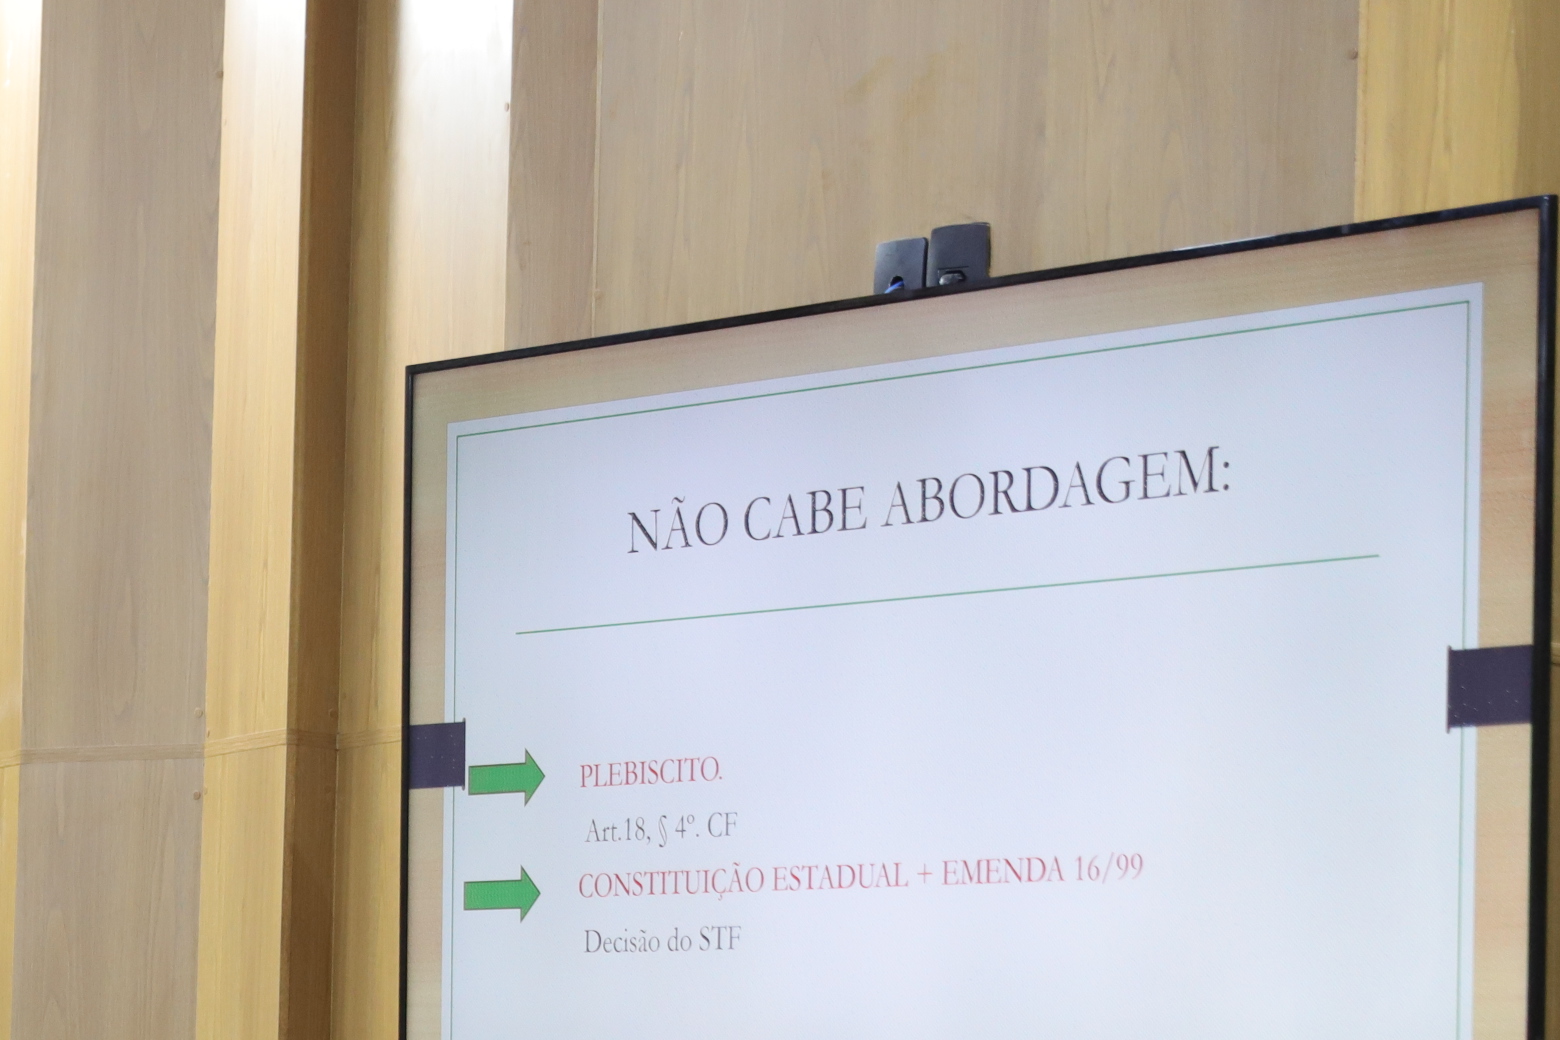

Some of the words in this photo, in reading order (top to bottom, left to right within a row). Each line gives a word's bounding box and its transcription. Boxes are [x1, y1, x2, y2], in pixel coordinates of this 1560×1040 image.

[627, 496, 729, 554] NÃO
[743, 485, 868, 541] CABE
[880, 445, 1231, 528] ABORDAGEM:
[580, 756, 723, 788] PLEBISCITO.
[585, 816, 651, 845] Art.18,
[658, 814, 668, 848] §
[707, 811, 738, 838] CF
[578, 861, 765, 901] CONSTITUIÇÃO
[773, 862, 909, 891] ESTADUAL
[917, 864, 933, 884] +
[942, 856, 1065, 886] EMENDA
[1075, 852, 1145, 881] 16/99
[584, 928, 661, 953] Decisão
[666, 926, 692, 952] do
[699, 925, 741, 951] STF
